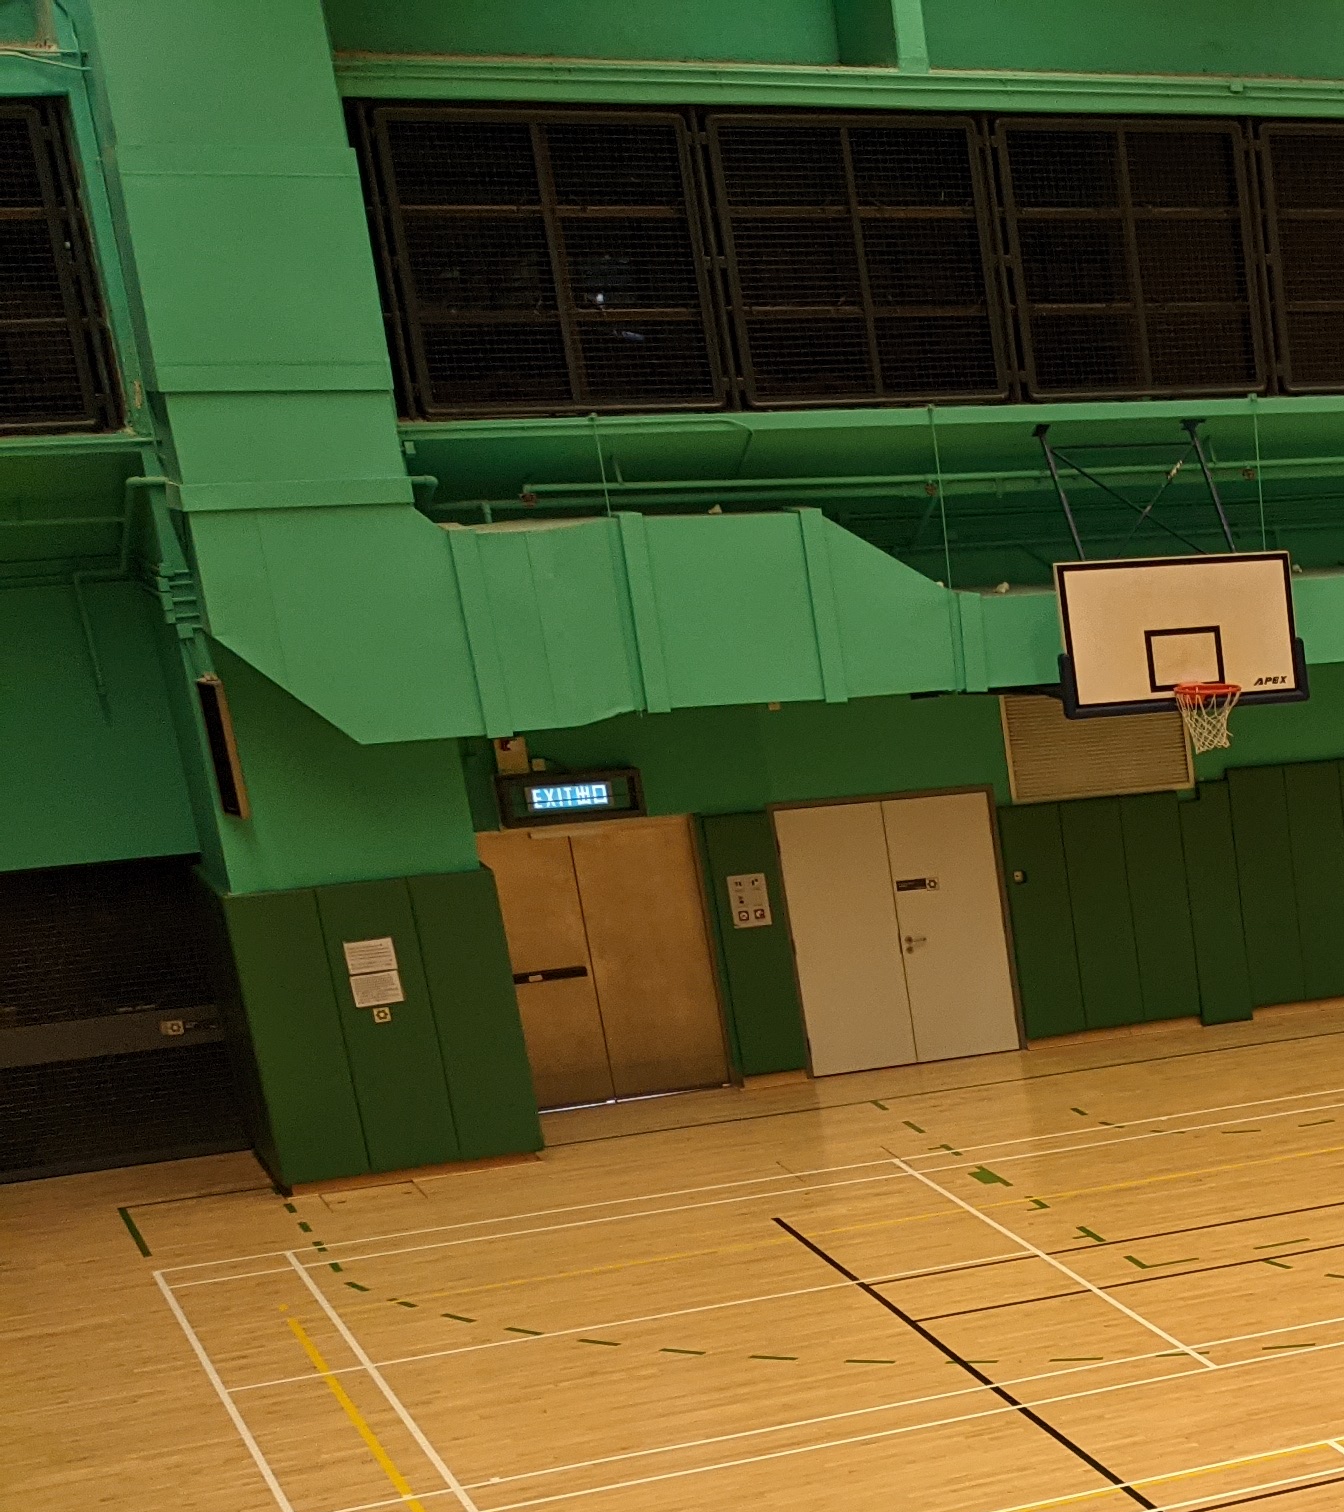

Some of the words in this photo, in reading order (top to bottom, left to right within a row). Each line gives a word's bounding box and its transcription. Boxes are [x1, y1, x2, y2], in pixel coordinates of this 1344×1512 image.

[1253, 675, 1288, 686] APEX
[531, 786, 573, 809] EXIT
[575, 784, 608, 805] 出口
